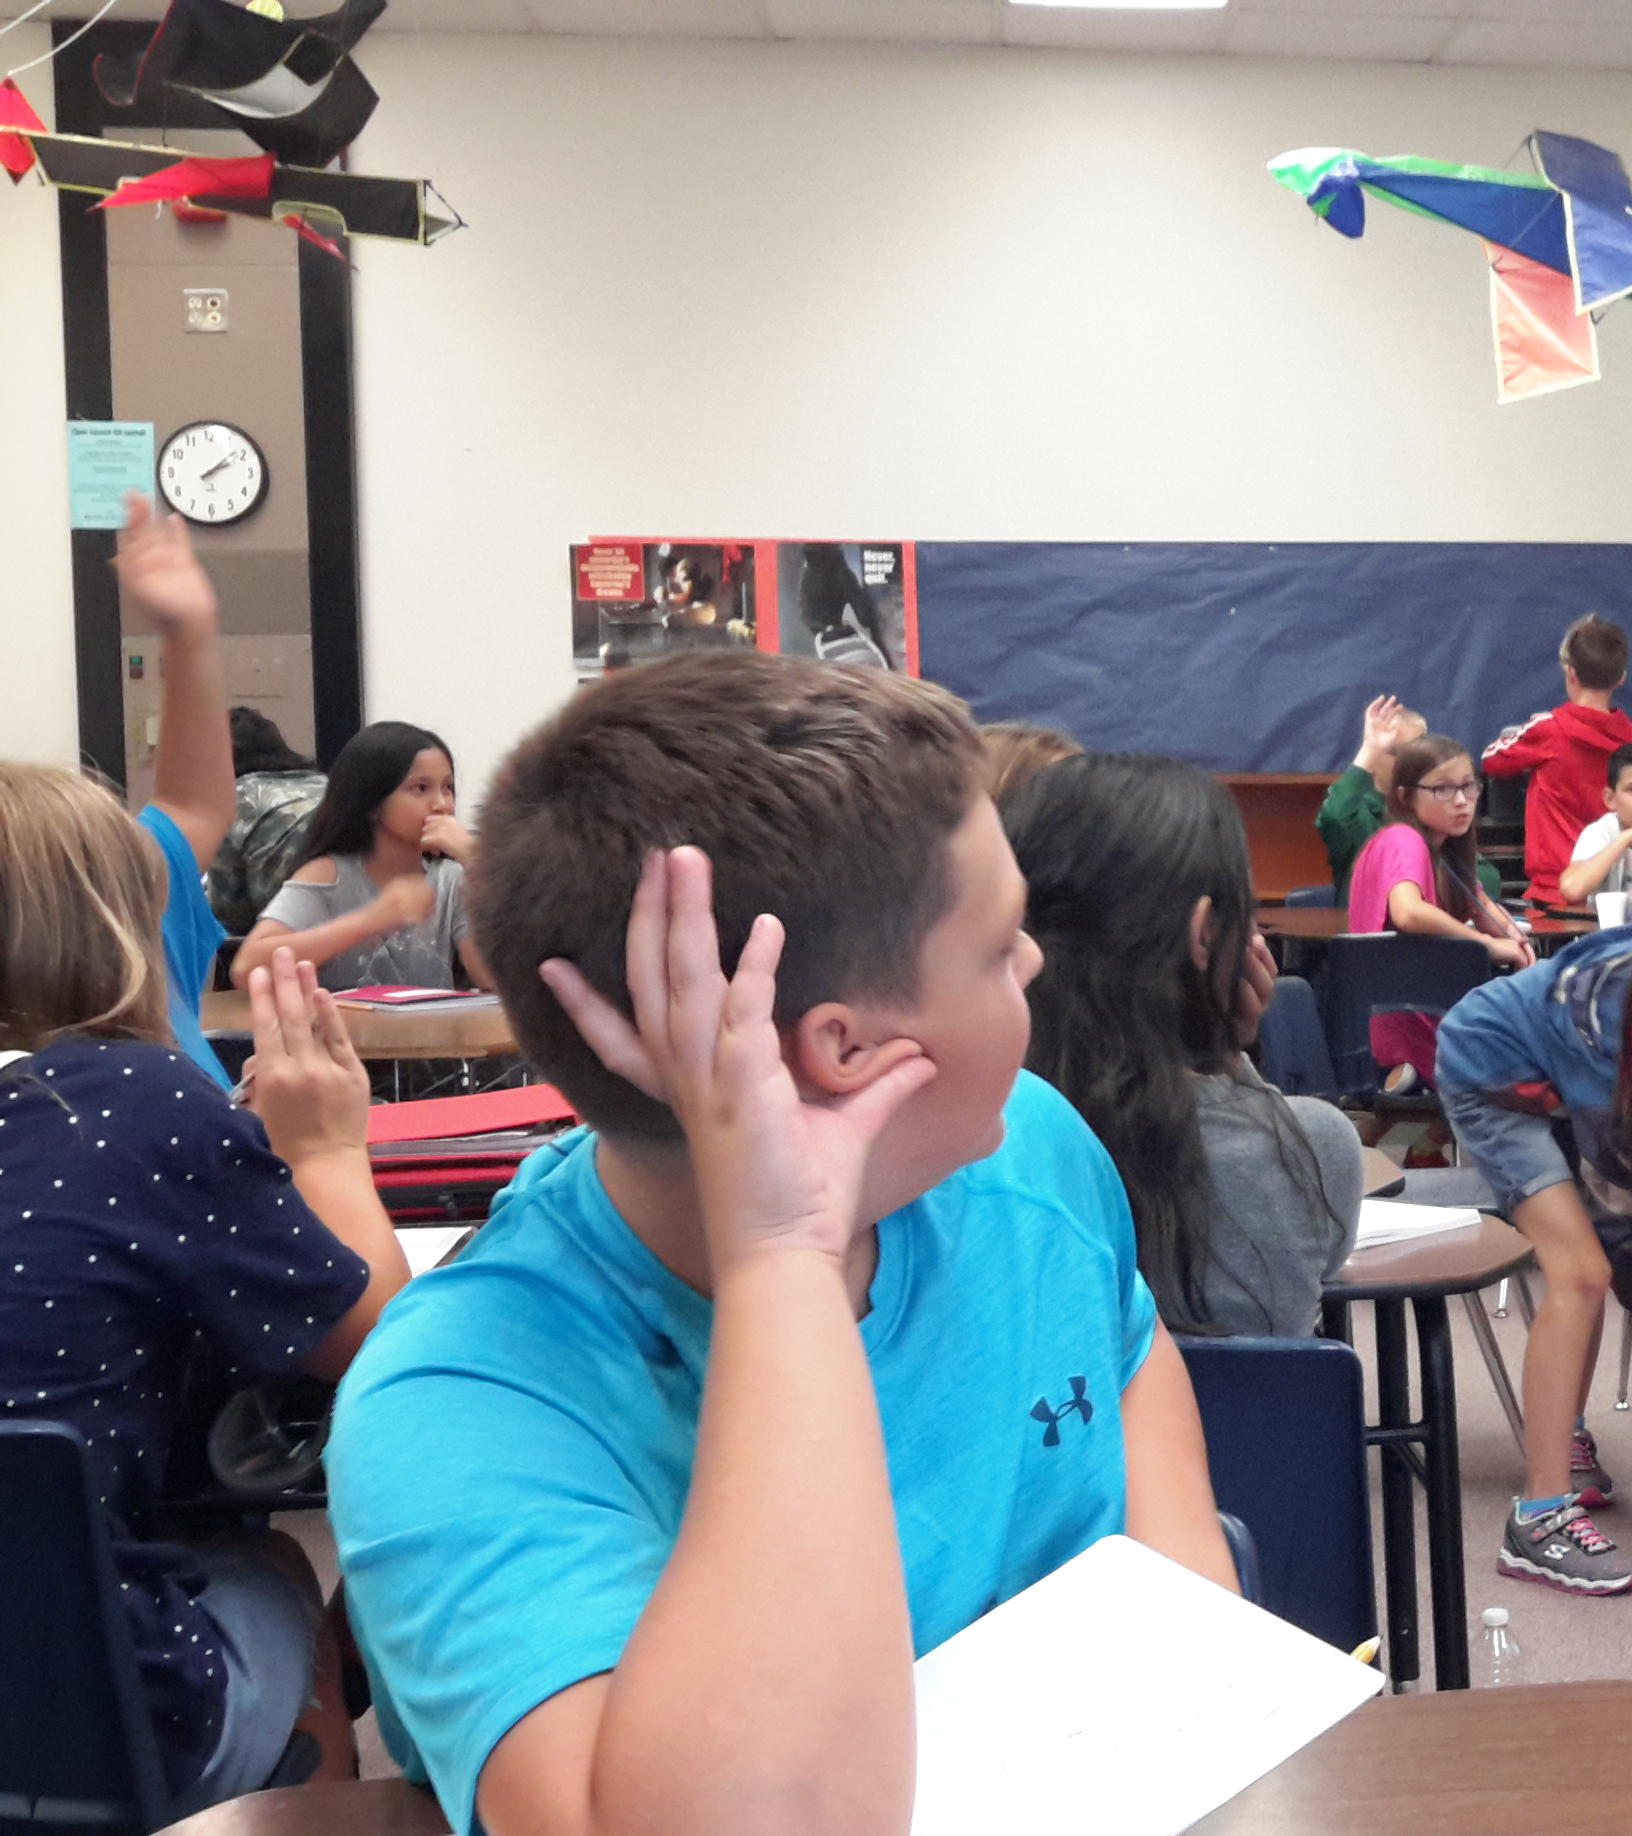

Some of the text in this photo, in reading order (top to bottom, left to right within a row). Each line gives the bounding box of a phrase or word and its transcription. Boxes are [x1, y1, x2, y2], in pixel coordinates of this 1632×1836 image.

[185, 435, 197, 448] 11
[172, 448, 184, 460] 10
[239, 449, 248, 462] 2
[167, 466, 175, 479] 9
[246, 466, 254, 480] 3
[174, 485, 182, 497] 8
[240, 485, 248, 497] 4
[190, 498, 197, 511] 7
[227, 498, 235, 511] 5
